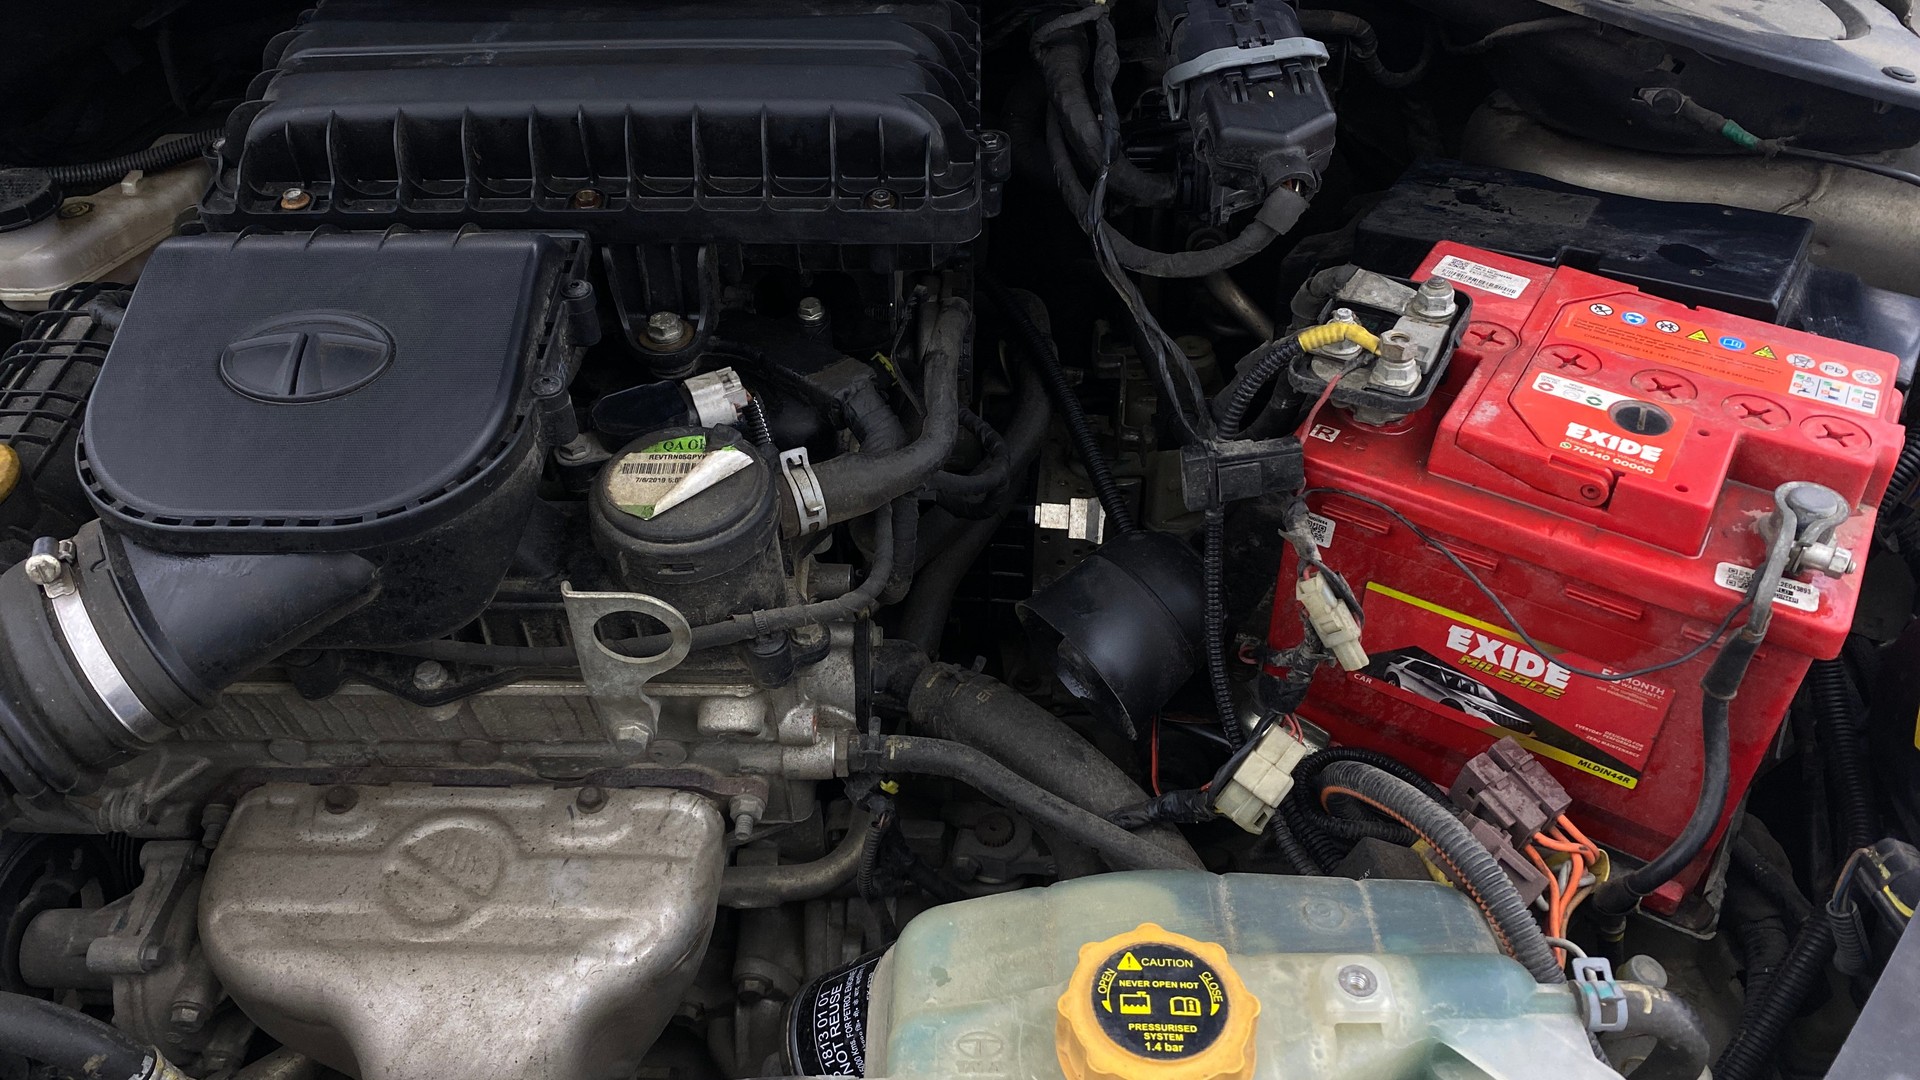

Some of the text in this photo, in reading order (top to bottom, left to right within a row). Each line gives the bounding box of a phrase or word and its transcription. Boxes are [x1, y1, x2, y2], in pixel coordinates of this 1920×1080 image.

[1825, 364, 1844, 375] Pb
[1314, 426, 1336, 441] R
[1565, 422, 1664, 463] EXIDE
[663, 439, 684, 452] QA
[1573, 445, 1654, 475] 70440 00000
[1779, 581, 1812, 595] 2E043893
[1446, 624, 1572, 690] EXIDE
[1353, 673, 1373, 685] CAR
[1457, 654, 1567, 701] MILEAGE
[1623, 677, 1666, 696] MONTH
[1575, 723, 1643, 752] EVERYDAY PERFORMANCE
[1632, 740, 1644, 749] FOR
[1577, 760, 1631, 784] MLDIN44R
[1141, 958, 1193, 968] CAUTION
[1097, 968, 1115, 994] OPEN
[1119, 980, 1199, 989] NEVER OPEN HOT
[1201, 971, 1223, 1003] CLOSE
[829, 983, 843, 1038] REUSE
[843, 993, 852, 1021] PETROL
[817, 990, 836, 1068] 1813 01 01
[844, 1020, 854, 1039] FOR
[1128, 1023, 1198, 1033] PRESSURISED
[1143, 1032, 1184, 1041] SYSTEM
[1145, 1042, 1184, 1052] 1.4 bar
[832, 1042, 854, 1076] NOT
